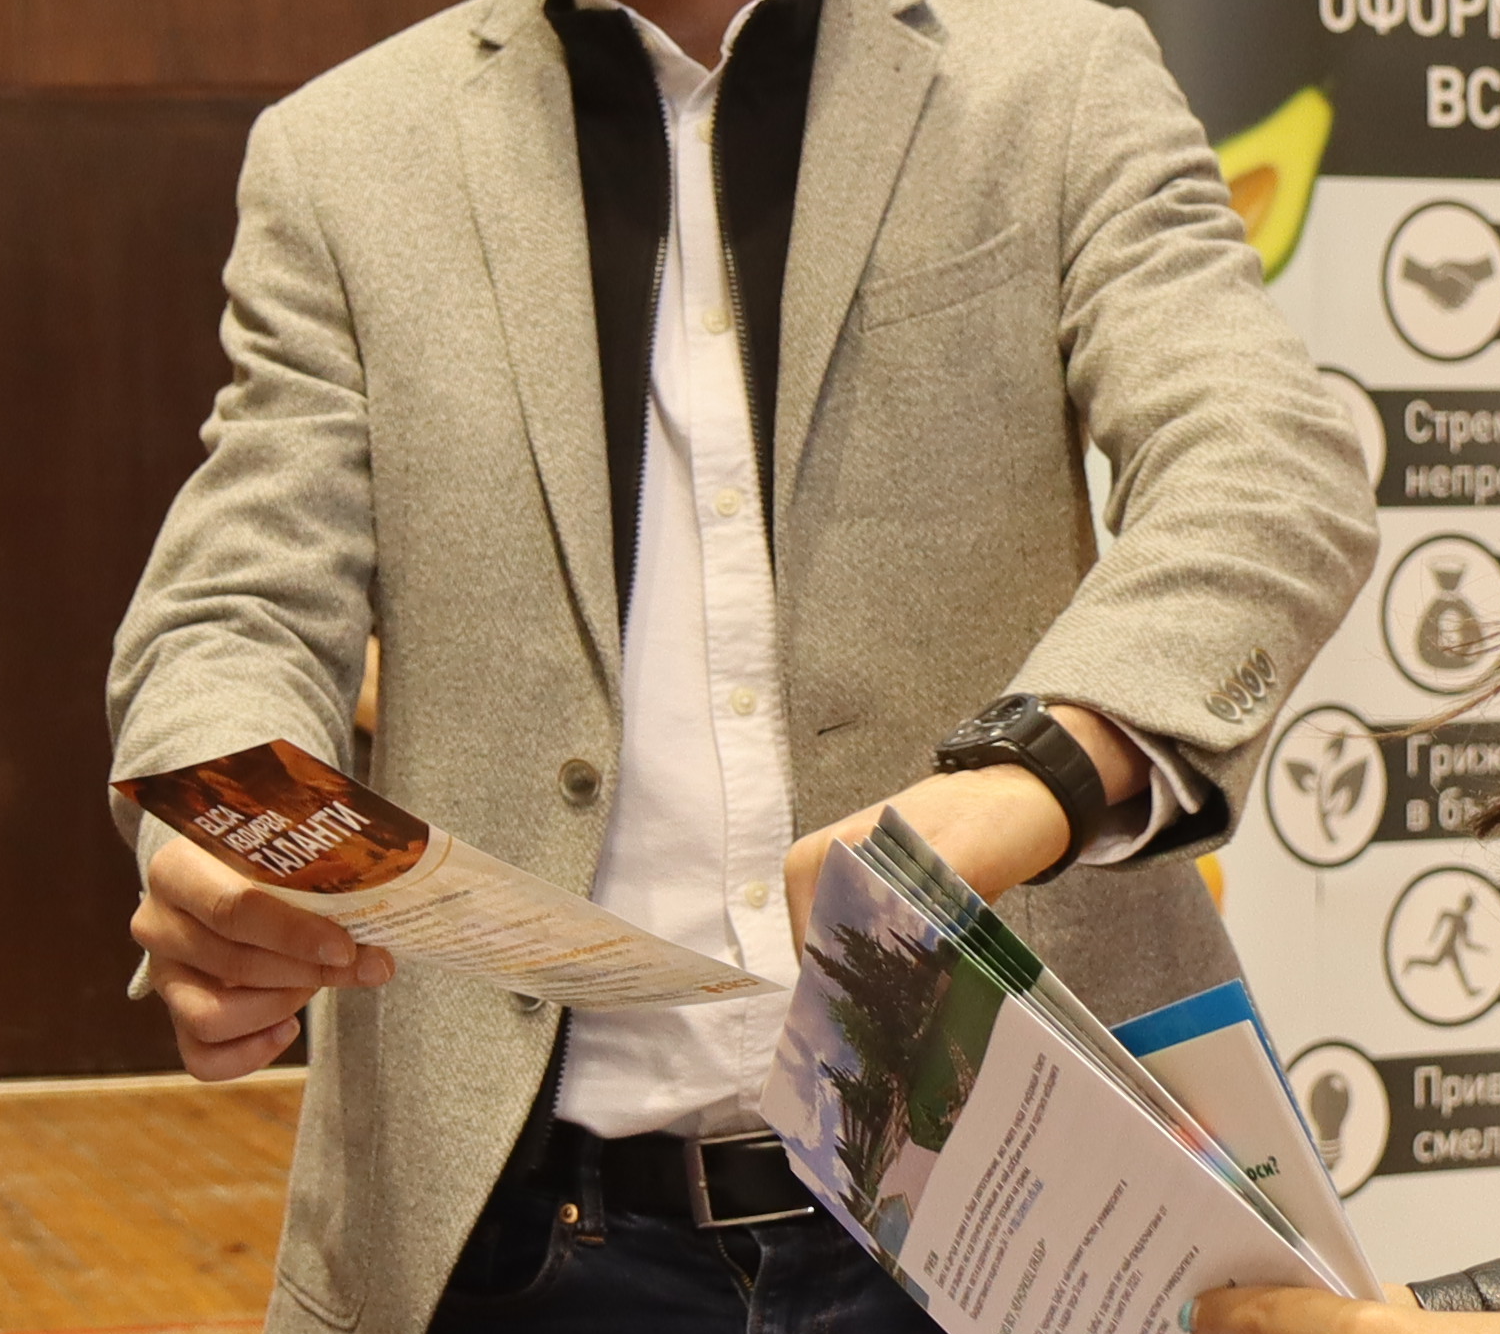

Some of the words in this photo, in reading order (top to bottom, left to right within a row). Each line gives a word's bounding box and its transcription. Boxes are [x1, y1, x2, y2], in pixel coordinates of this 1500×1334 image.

[193, 804, 246, 837] ELICA
[222, 809, 293, 854] ИЗДИРВА
[247, 800, 371, 878] ТАЛАНТИ
